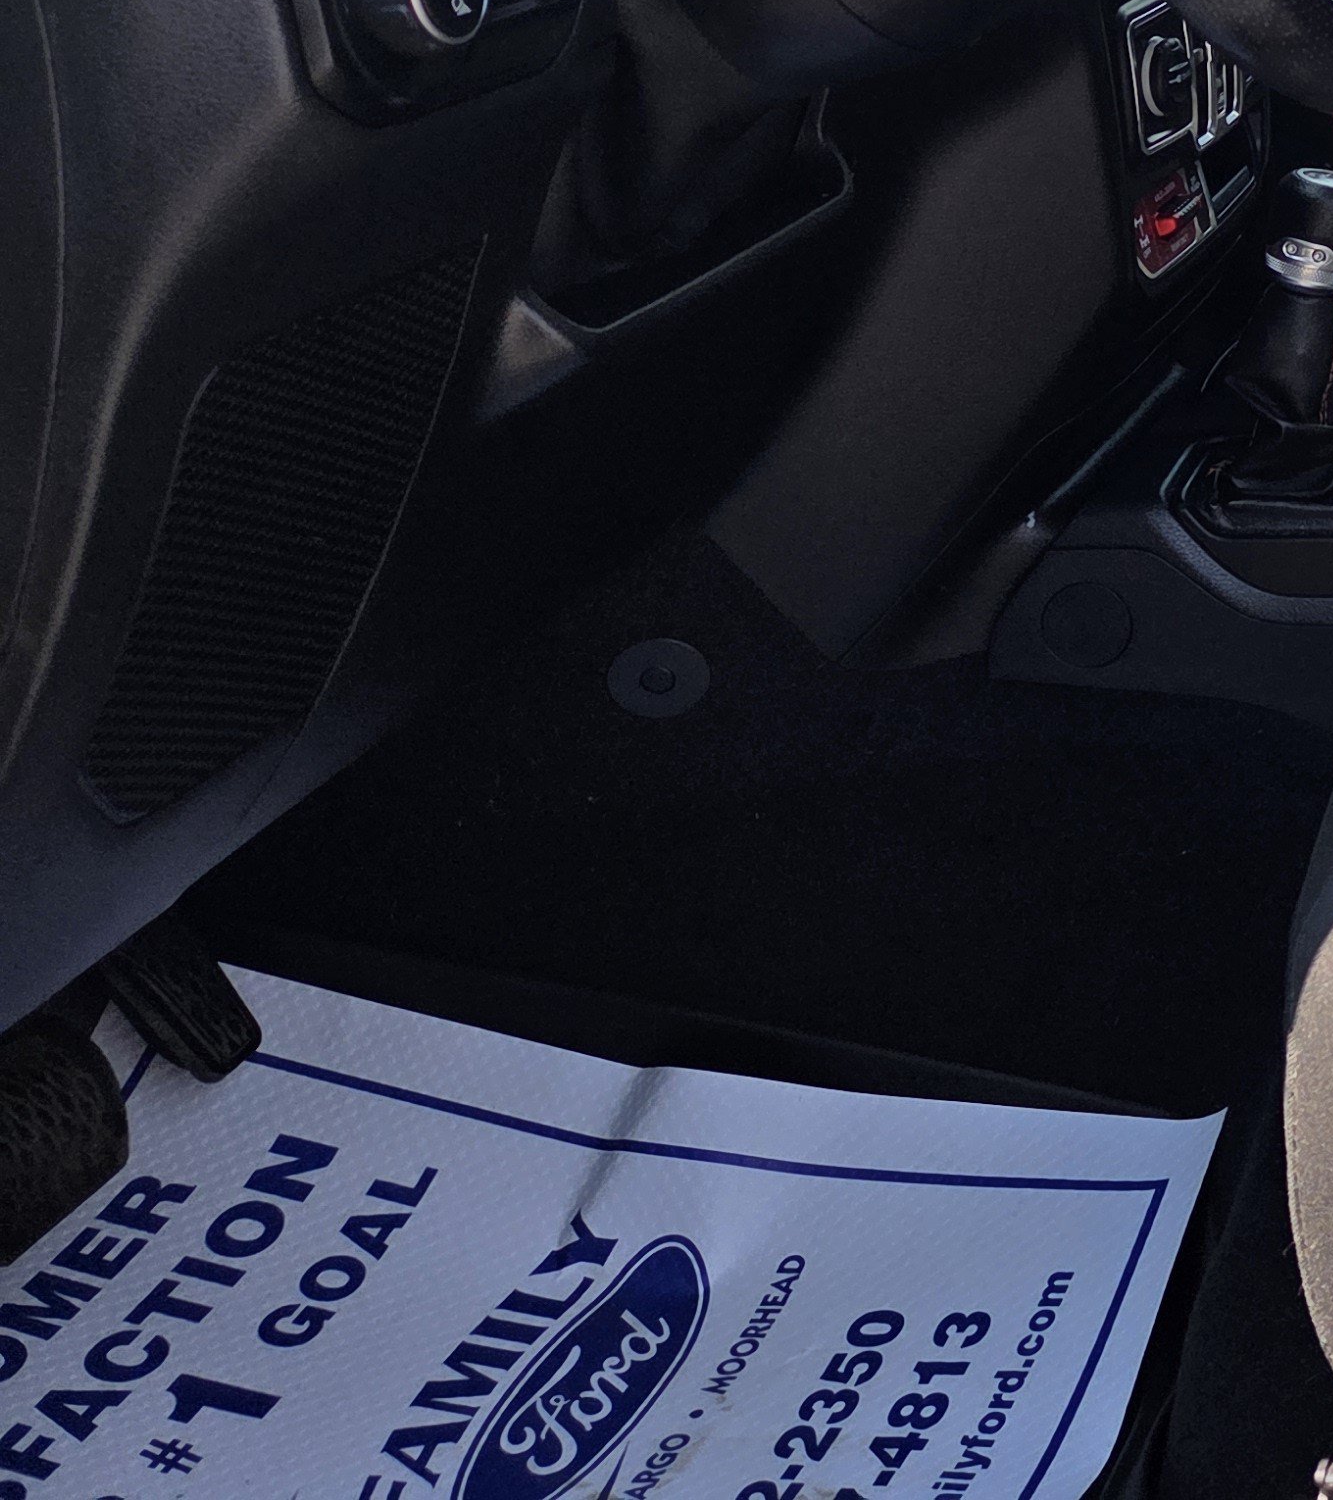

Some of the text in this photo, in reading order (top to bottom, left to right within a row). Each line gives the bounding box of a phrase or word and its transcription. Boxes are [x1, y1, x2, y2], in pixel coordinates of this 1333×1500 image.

[0, 1133, 340, 1500] FACTION
[257, 1166, 439, 1348] GOAL
[702, 1254, 806, 1395] MOORHEAD
[500, 1309, 671, 1476] Ford
[832, 1310, 992, 1500] -4813
[931, 1269, 1075, 1500] ilyford.com
